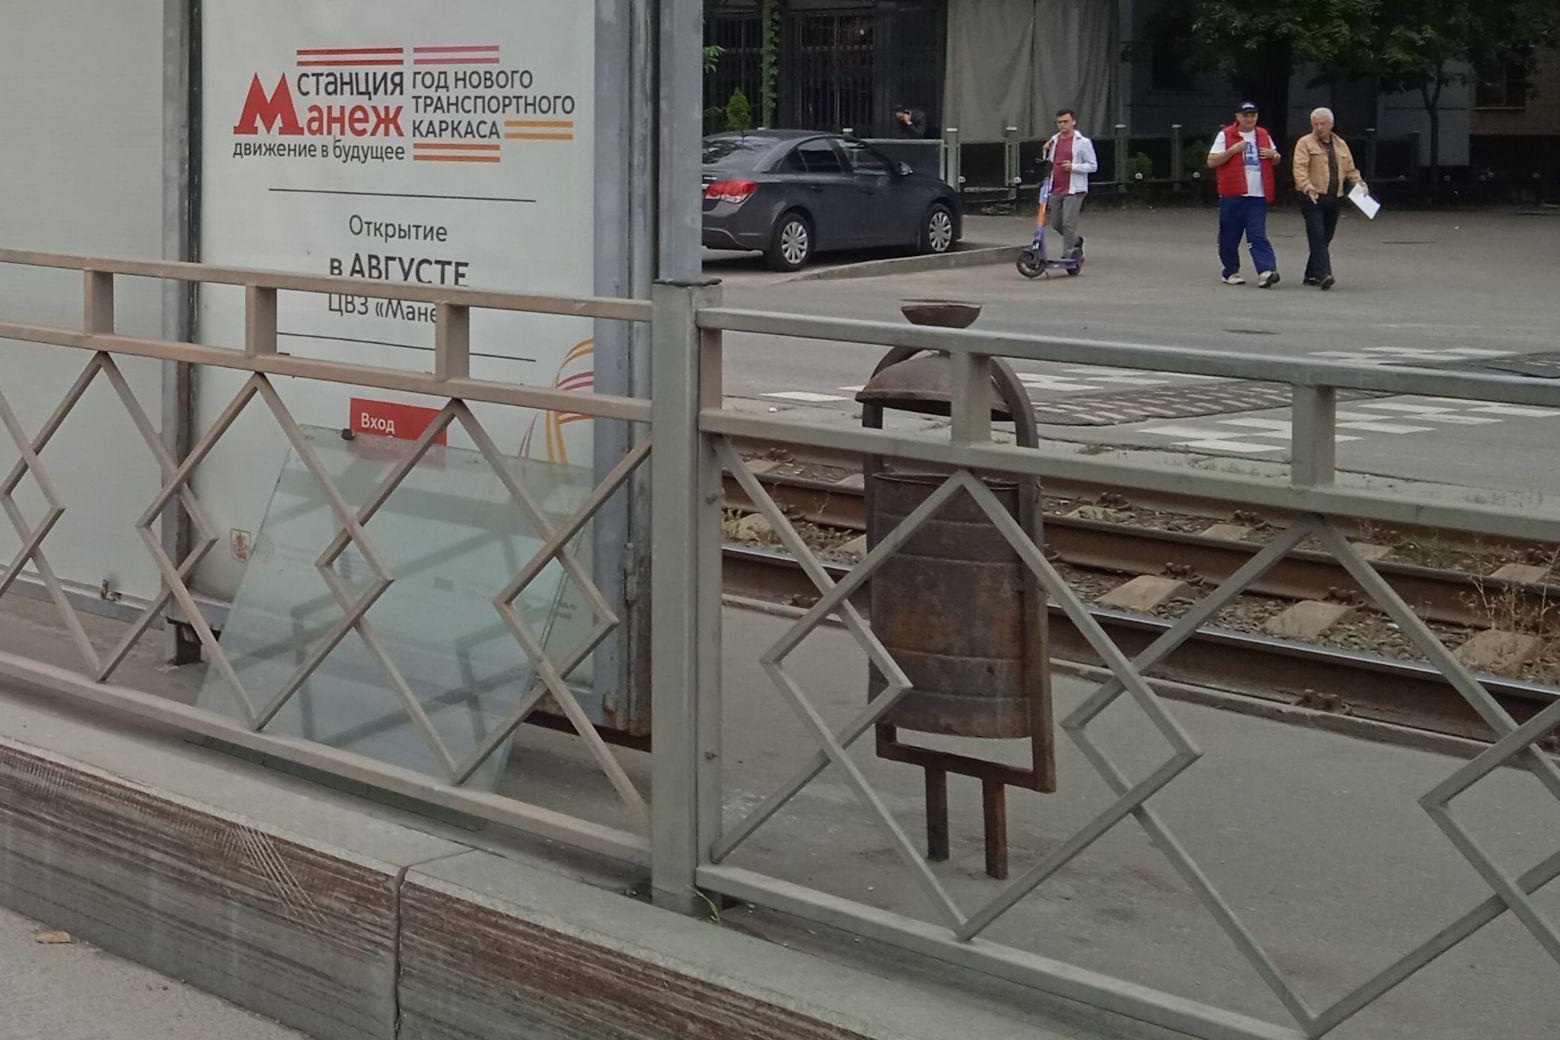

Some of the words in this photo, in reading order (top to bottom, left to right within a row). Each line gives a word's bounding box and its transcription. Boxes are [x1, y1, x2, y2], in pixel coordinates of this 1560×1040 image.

[412, 71, 449, 93] ГОД
[454, 70, 534, 91] НОВОГО
[412, 94, 576, 115] ТРАНСПОРТНОГО
[412, 120, 501, 139] КАРКАСА
[233, 140, 317, 160] движение
[321, 144, 329, 157] в
[333, 137, 406, 164] будущее
[349, 214, 448, 243] Открытие
[329, 257, 343, 276] в
[349, 252, 470, 287] АВГУСТЕ
[360, 412, 395, 435] Вход
